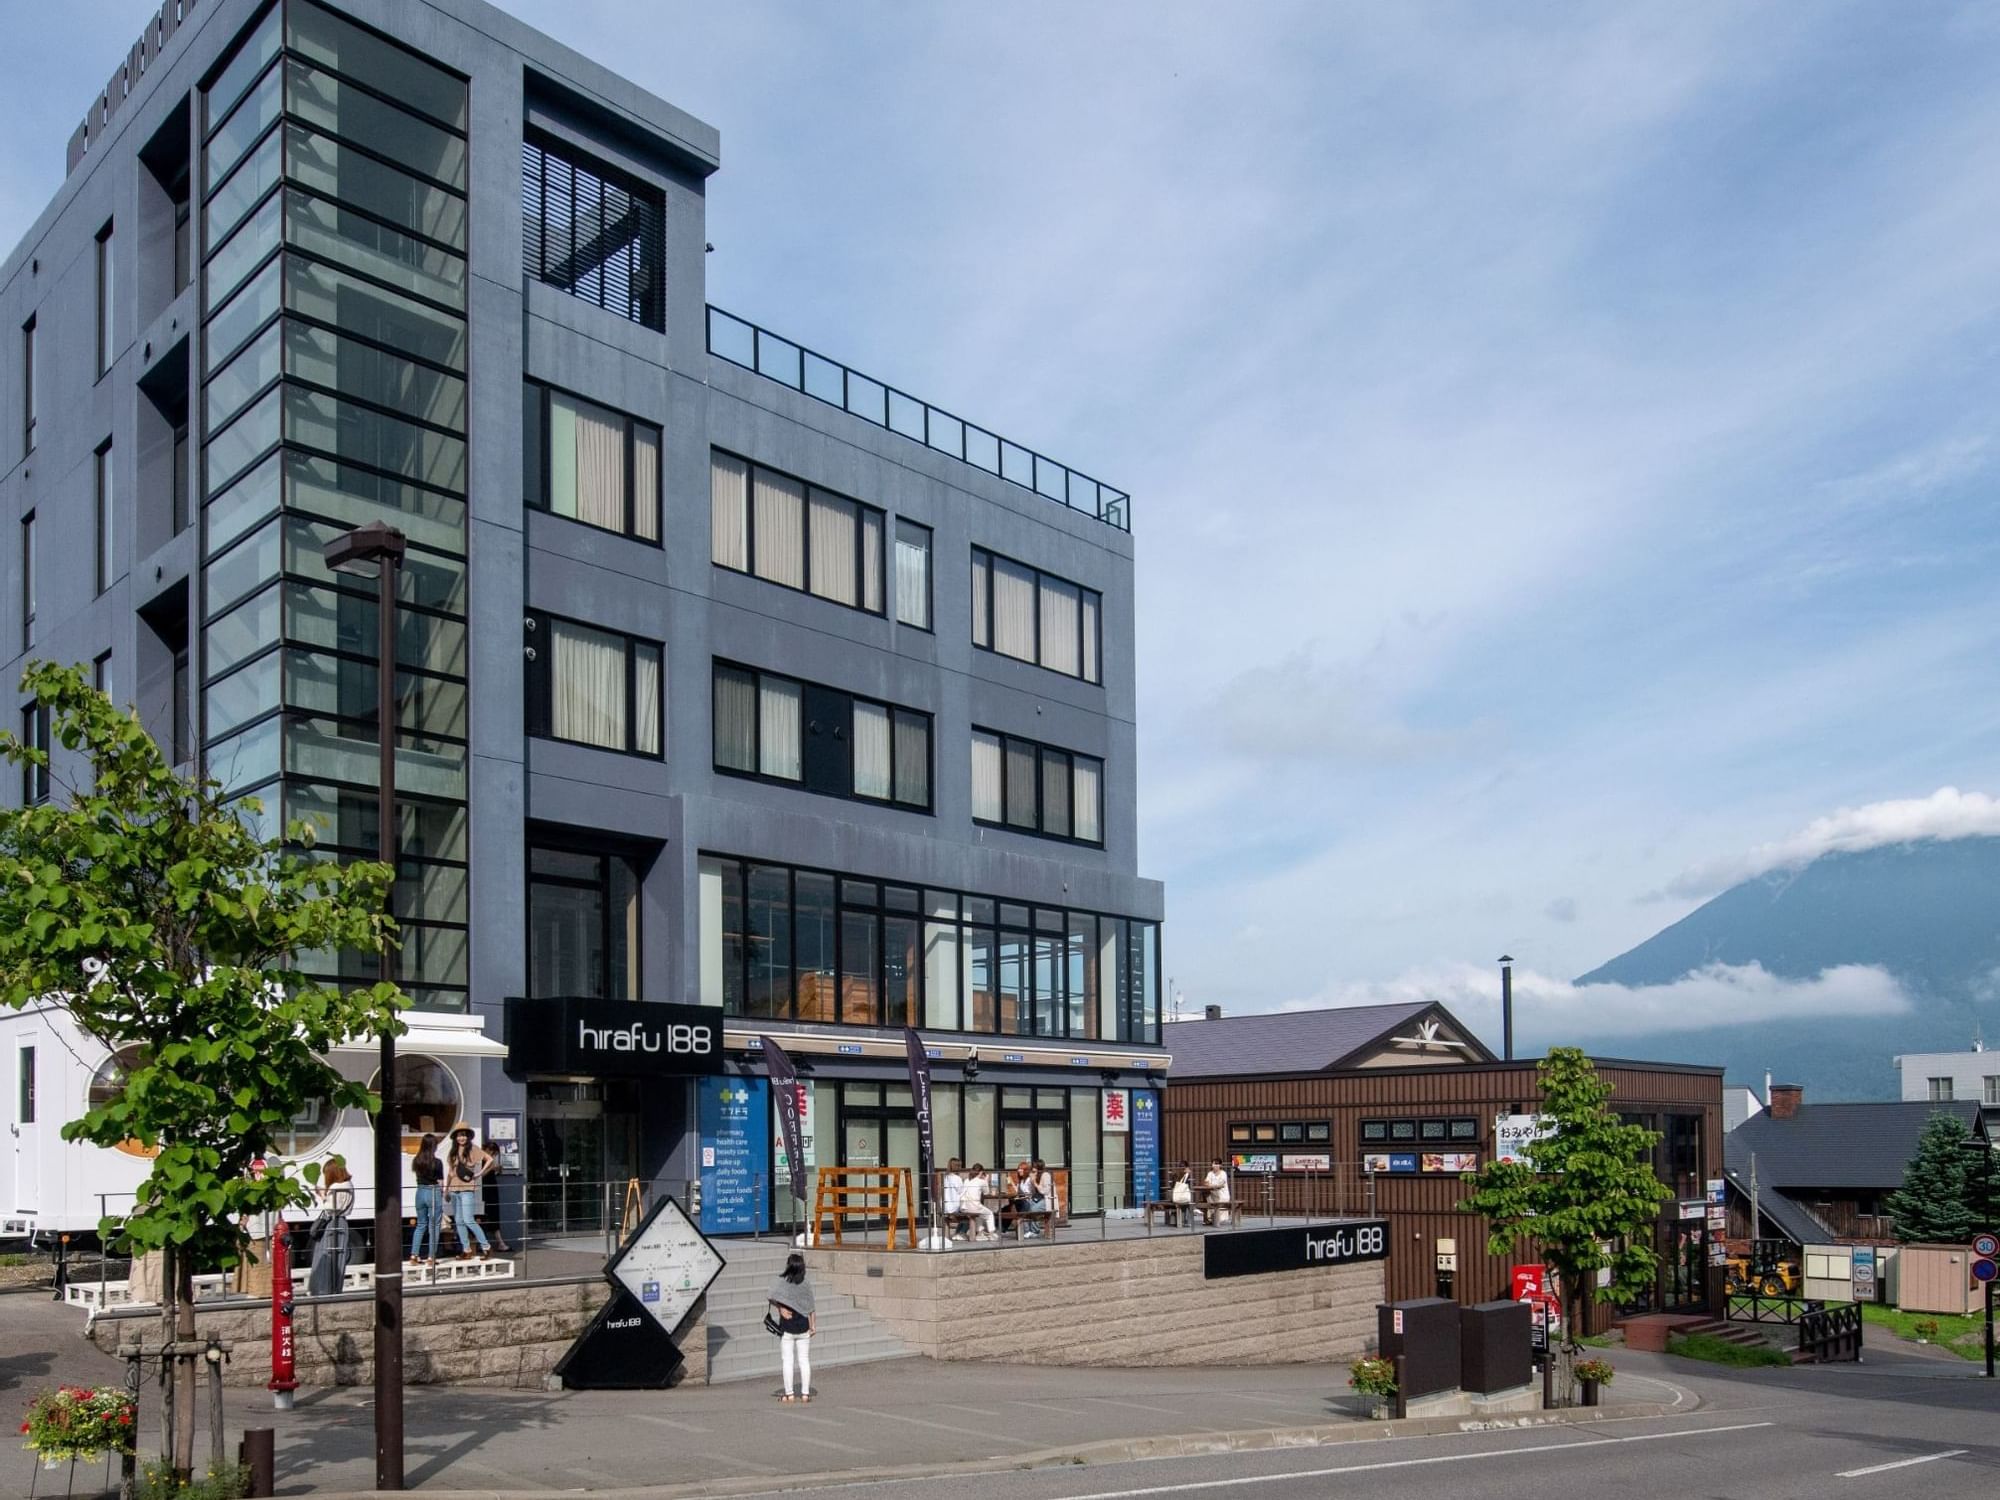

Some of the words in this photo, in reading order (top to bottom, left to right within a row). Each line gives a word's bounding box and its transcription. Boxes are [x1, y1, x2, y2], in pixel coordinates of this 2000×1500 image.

[579, 1019, 660, 1052] hirafu
[667, 1024, 711, 1054] 188
[1106, 1092, 1124, 1120] 薬
[716, 1148, 736, 1156] beauty
[716, 1168, 730, 1176] daily
[729, 1195, 744, 1203] drink
[1306, 1229, 1354, 1260] hirafu
[1356, 1226, 1383, 1255] 188
[1979, 1241, 1993, 1252] 30
[281, 1326, 291, 1357] 消火栓
